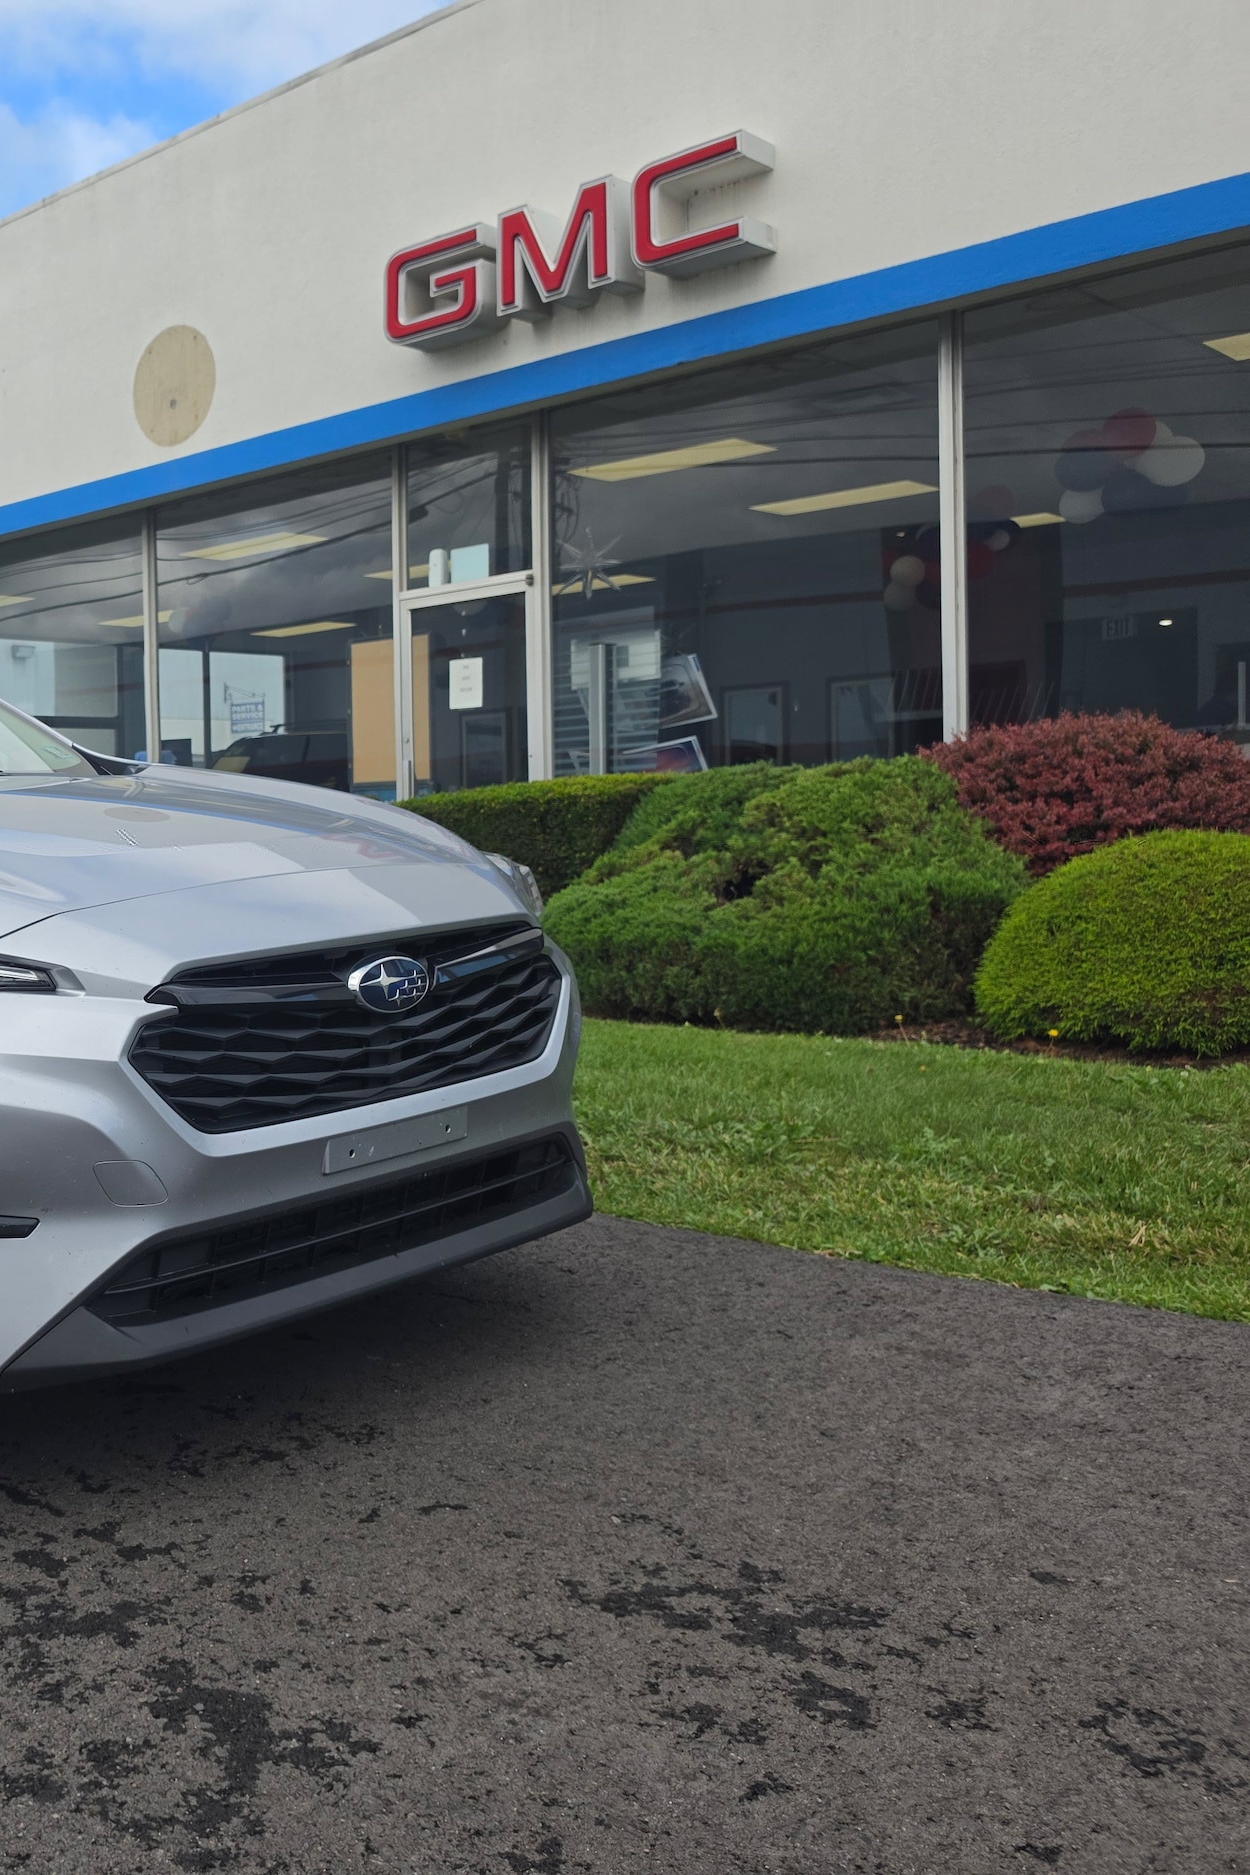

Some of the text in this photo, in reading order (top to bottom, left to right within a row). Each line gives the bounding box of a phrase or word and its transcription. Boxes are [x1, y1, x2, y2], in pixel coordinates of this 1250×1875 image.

[384, 129, 776, 348] GMC
[232, 704, 256, 713] PARTS
[232, 712, 264, 721] SERVICE
